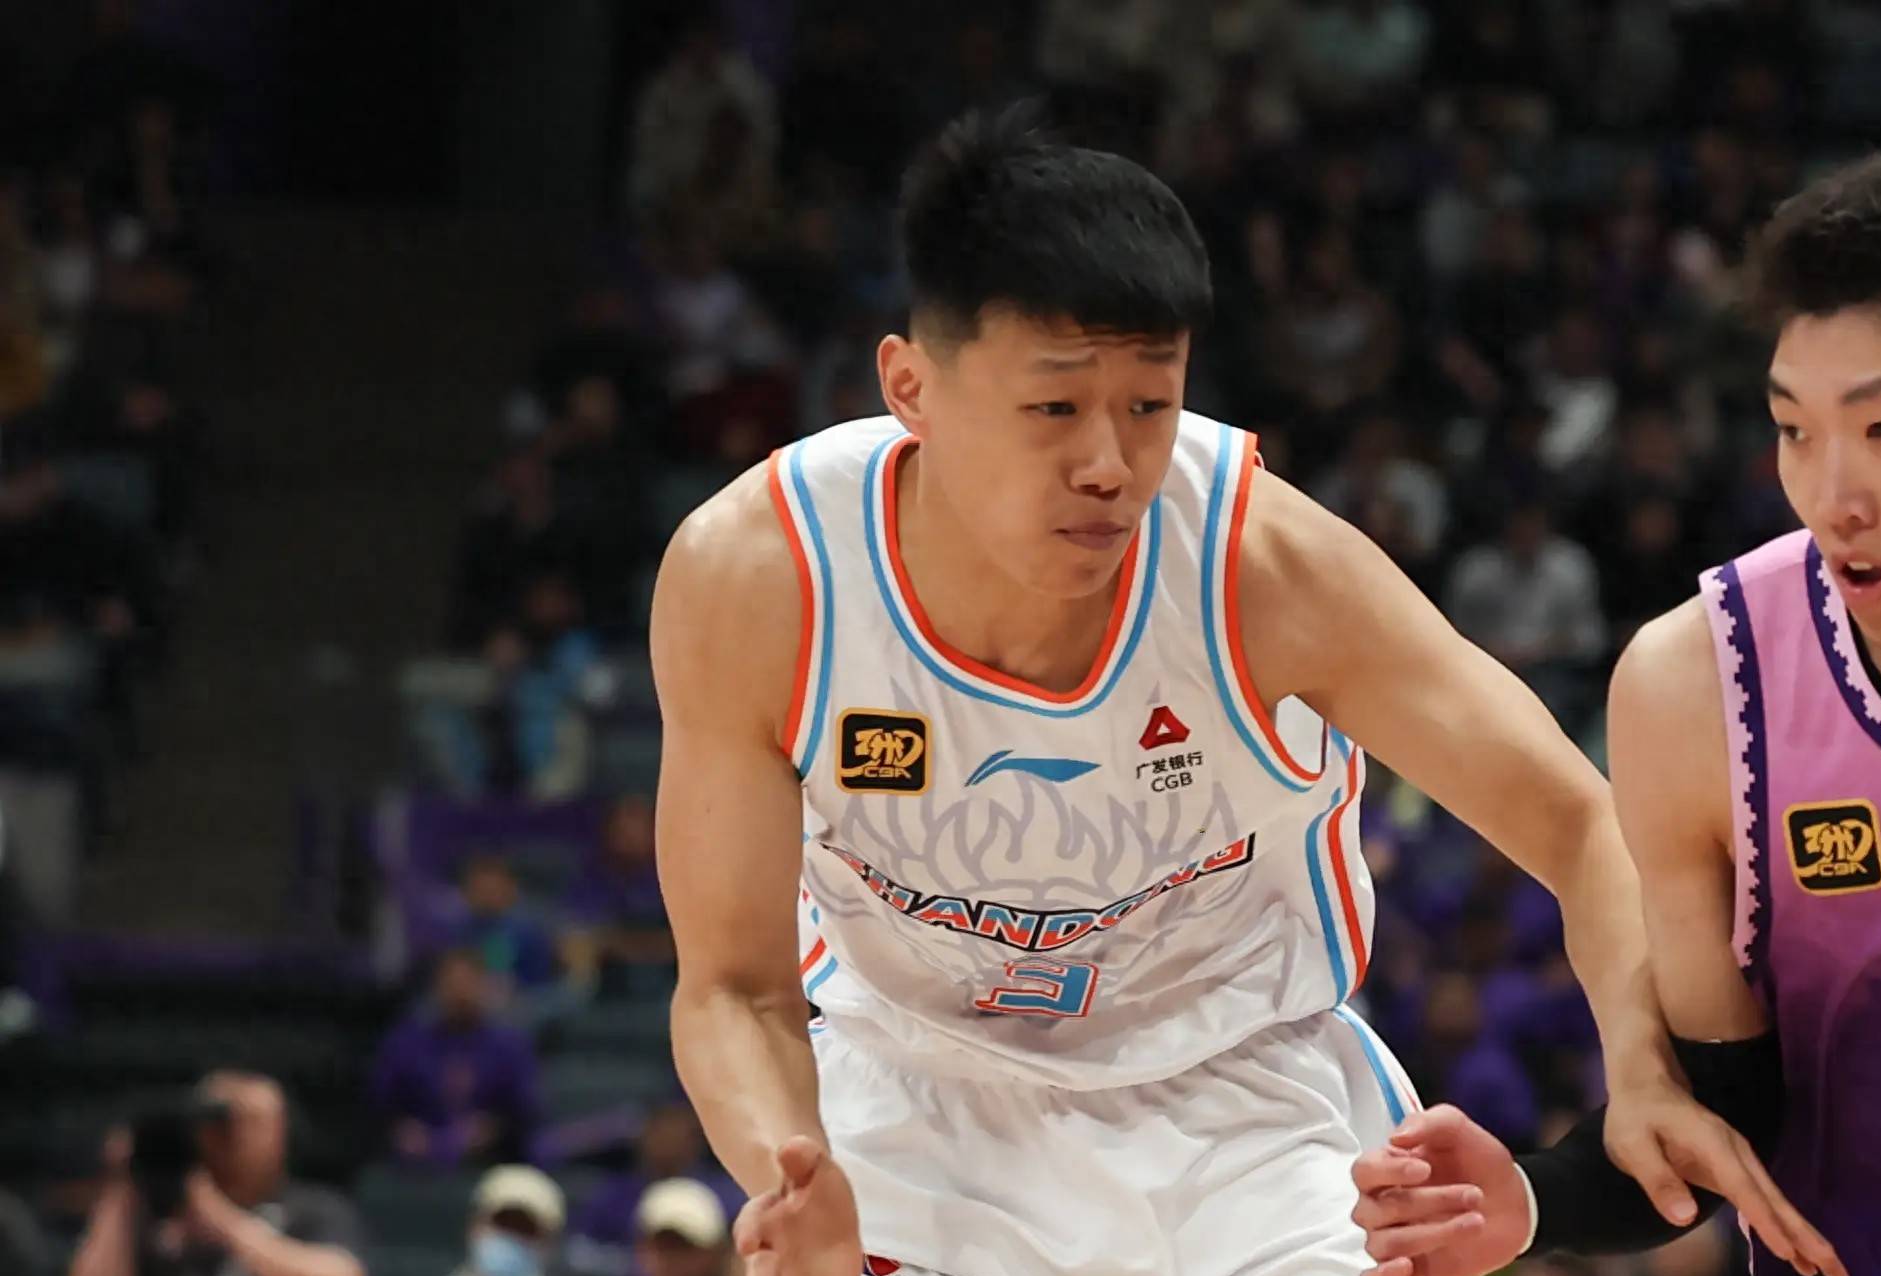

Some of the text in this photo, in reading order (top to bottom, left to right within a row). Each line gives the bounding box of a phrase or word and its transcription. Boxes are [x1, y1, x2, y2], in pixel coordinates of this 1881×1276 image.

[1136, 751, 1203, 779] 广发银行
[1151, 772, 1193, 792] CGB
